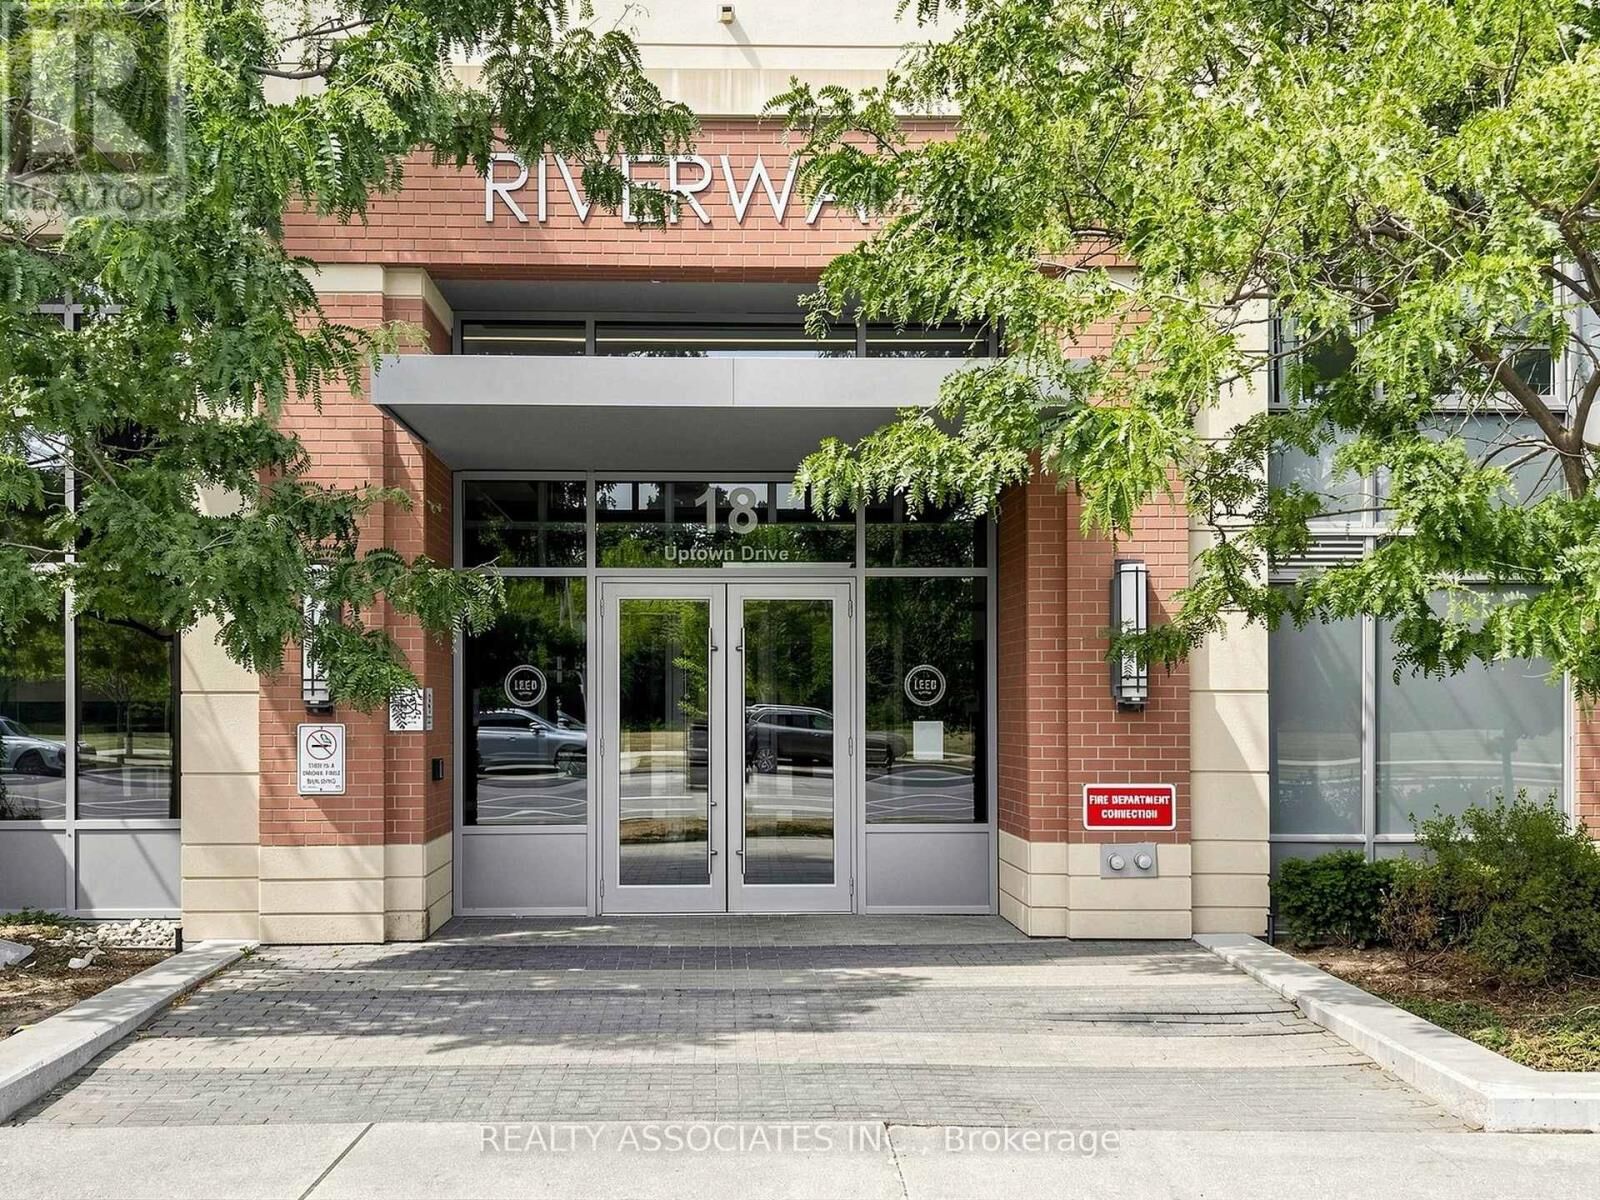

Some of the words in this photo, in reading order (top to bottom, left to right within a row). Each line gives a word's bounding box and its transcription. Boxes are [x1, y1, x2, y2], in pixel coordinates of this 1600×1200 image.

[695, 486, 758, 534] 18
[664, 545, 734, 564] Uptown
[741, 546, 789, 561] Drive
[1089, 795, 1109, 805] FIRE
[1111, 795, 1170, 805] DEPARTMENT
[1101, 809, 1158, 819] CONNECTION
